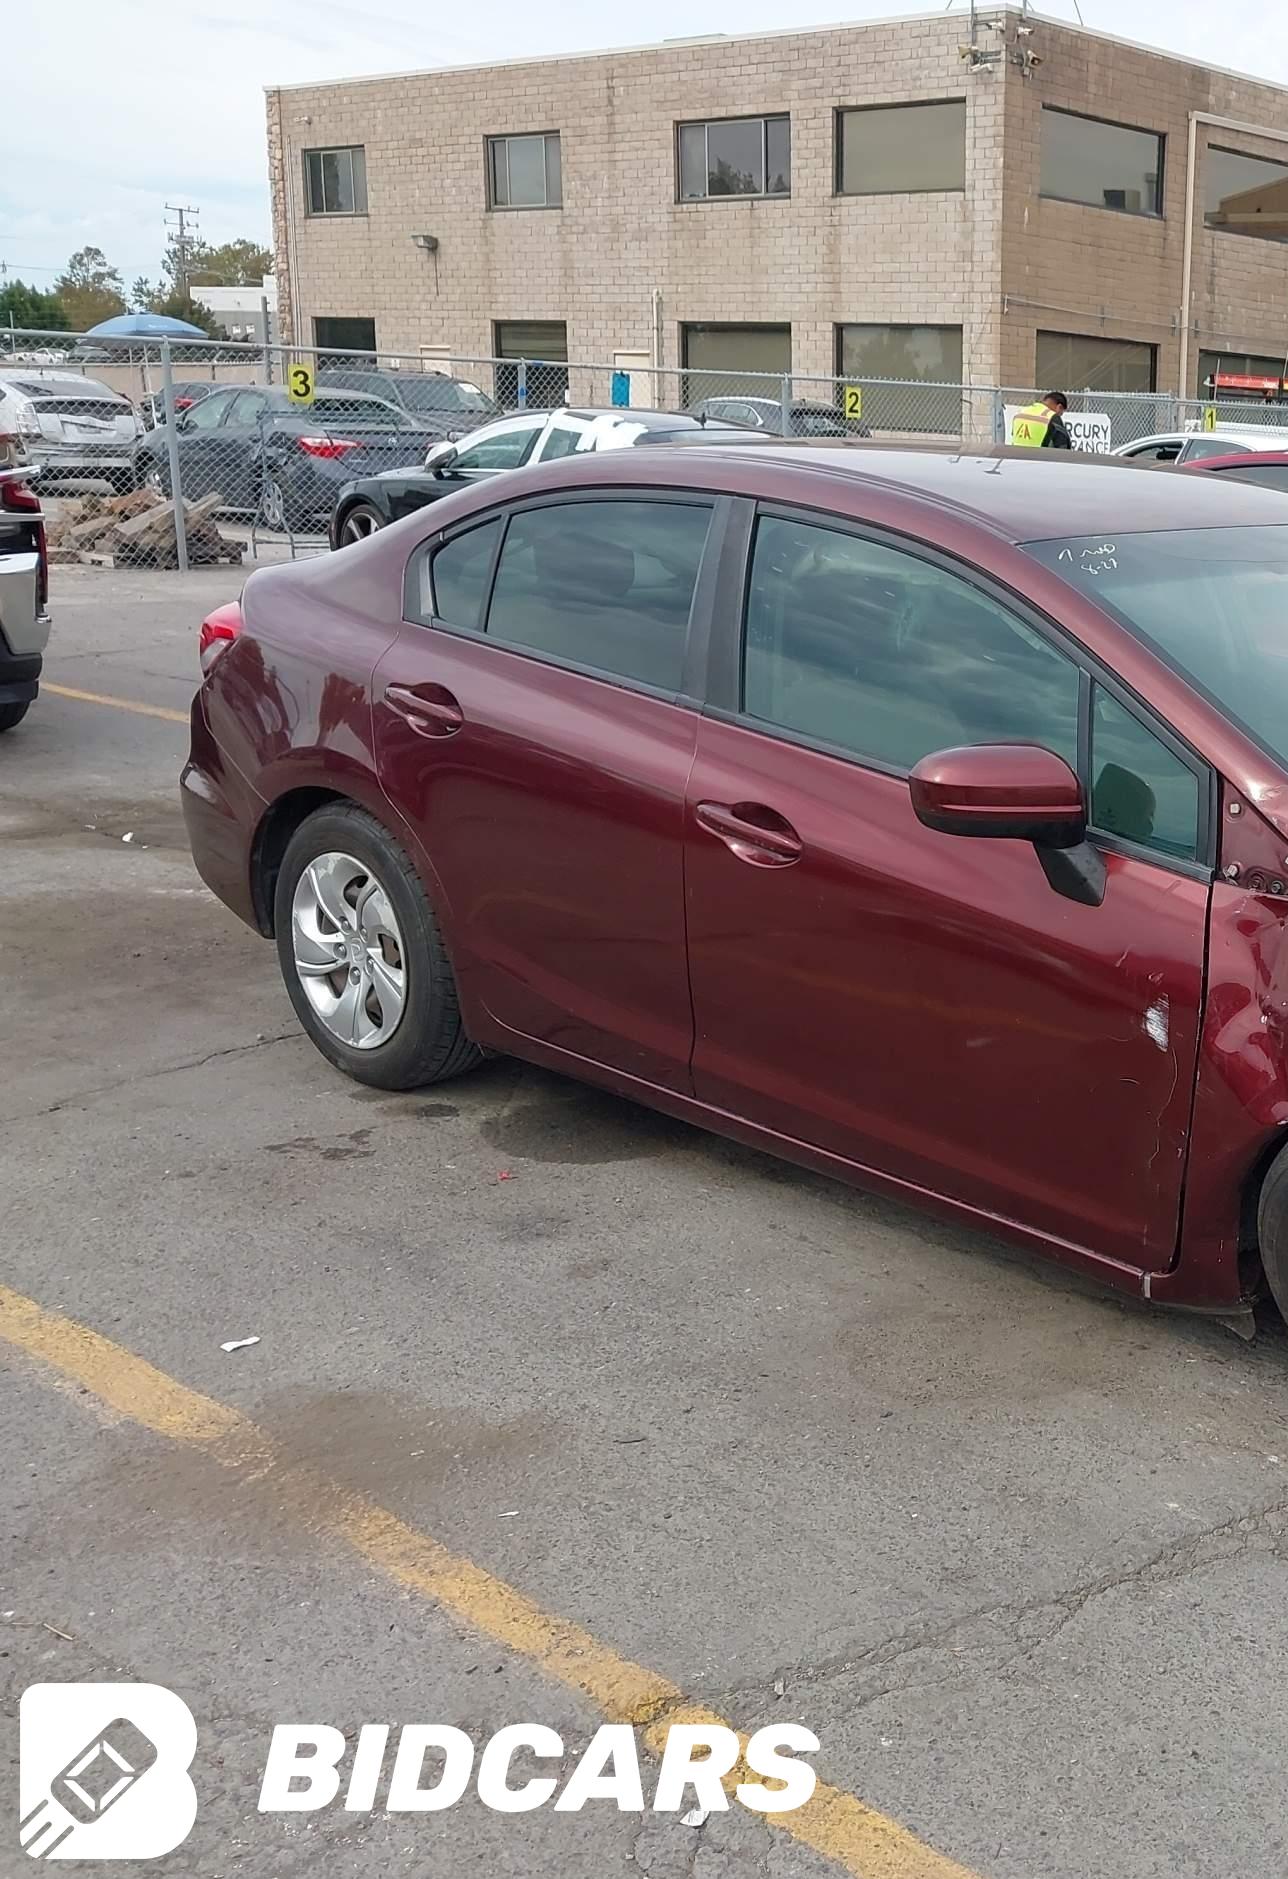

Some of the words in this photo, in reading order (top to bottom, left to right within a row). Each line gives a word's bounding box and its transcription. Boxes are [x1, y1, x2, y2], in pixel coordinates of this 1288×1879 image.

[293, 370, 311, 398] 3
[848, 391, 859, 414] 2
[1207, 410, 1214, 430] 1
